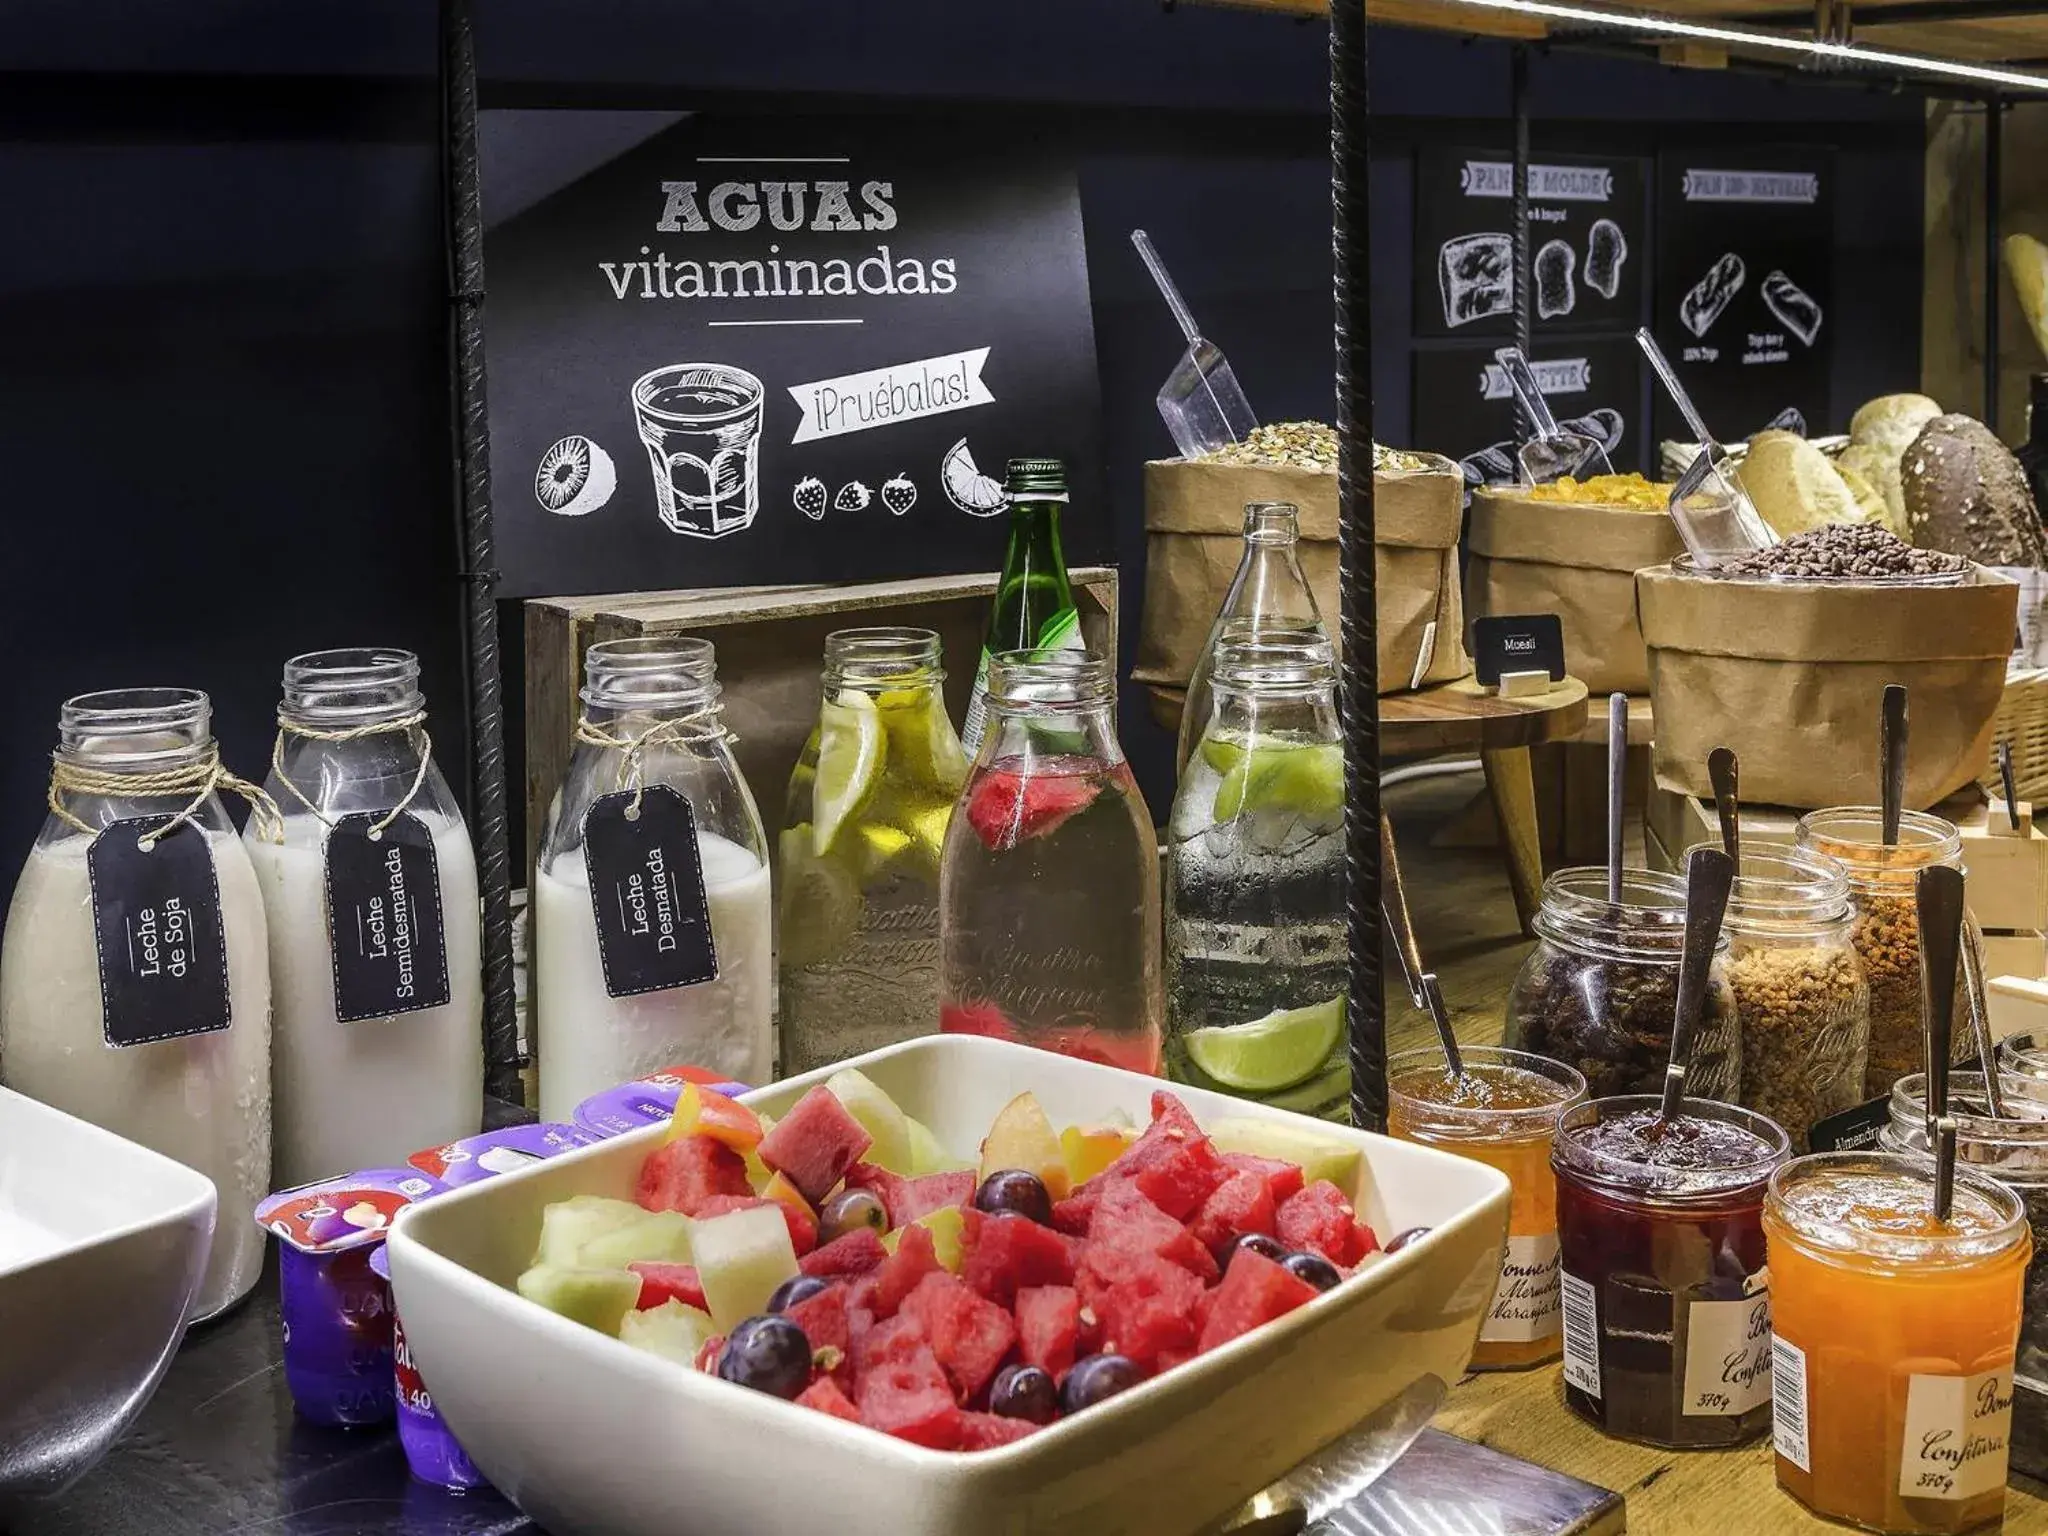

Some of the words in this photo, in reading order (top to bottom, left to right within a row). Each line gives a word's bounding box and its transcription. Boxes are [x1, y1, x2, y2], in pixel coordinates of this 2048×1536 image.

[656, 181, 898, 232] AGUAS
[1543, 172, 1601, 195] MOLDE
[599, 245, 958, 300] vitaminadas
[814, 360, 970, 433] ¡Pruébalas!
[162, 897, 187, 943] Soja
[366, 896, 387, 959] Leche
[385, 847, 414, 997] Semidesnatada
[627, 874, 649, 936] Leche
[647, 848, 677, 953] Desnatada
[138, 908, 160, 977] Leche
[168, 949, 187, 977] de
